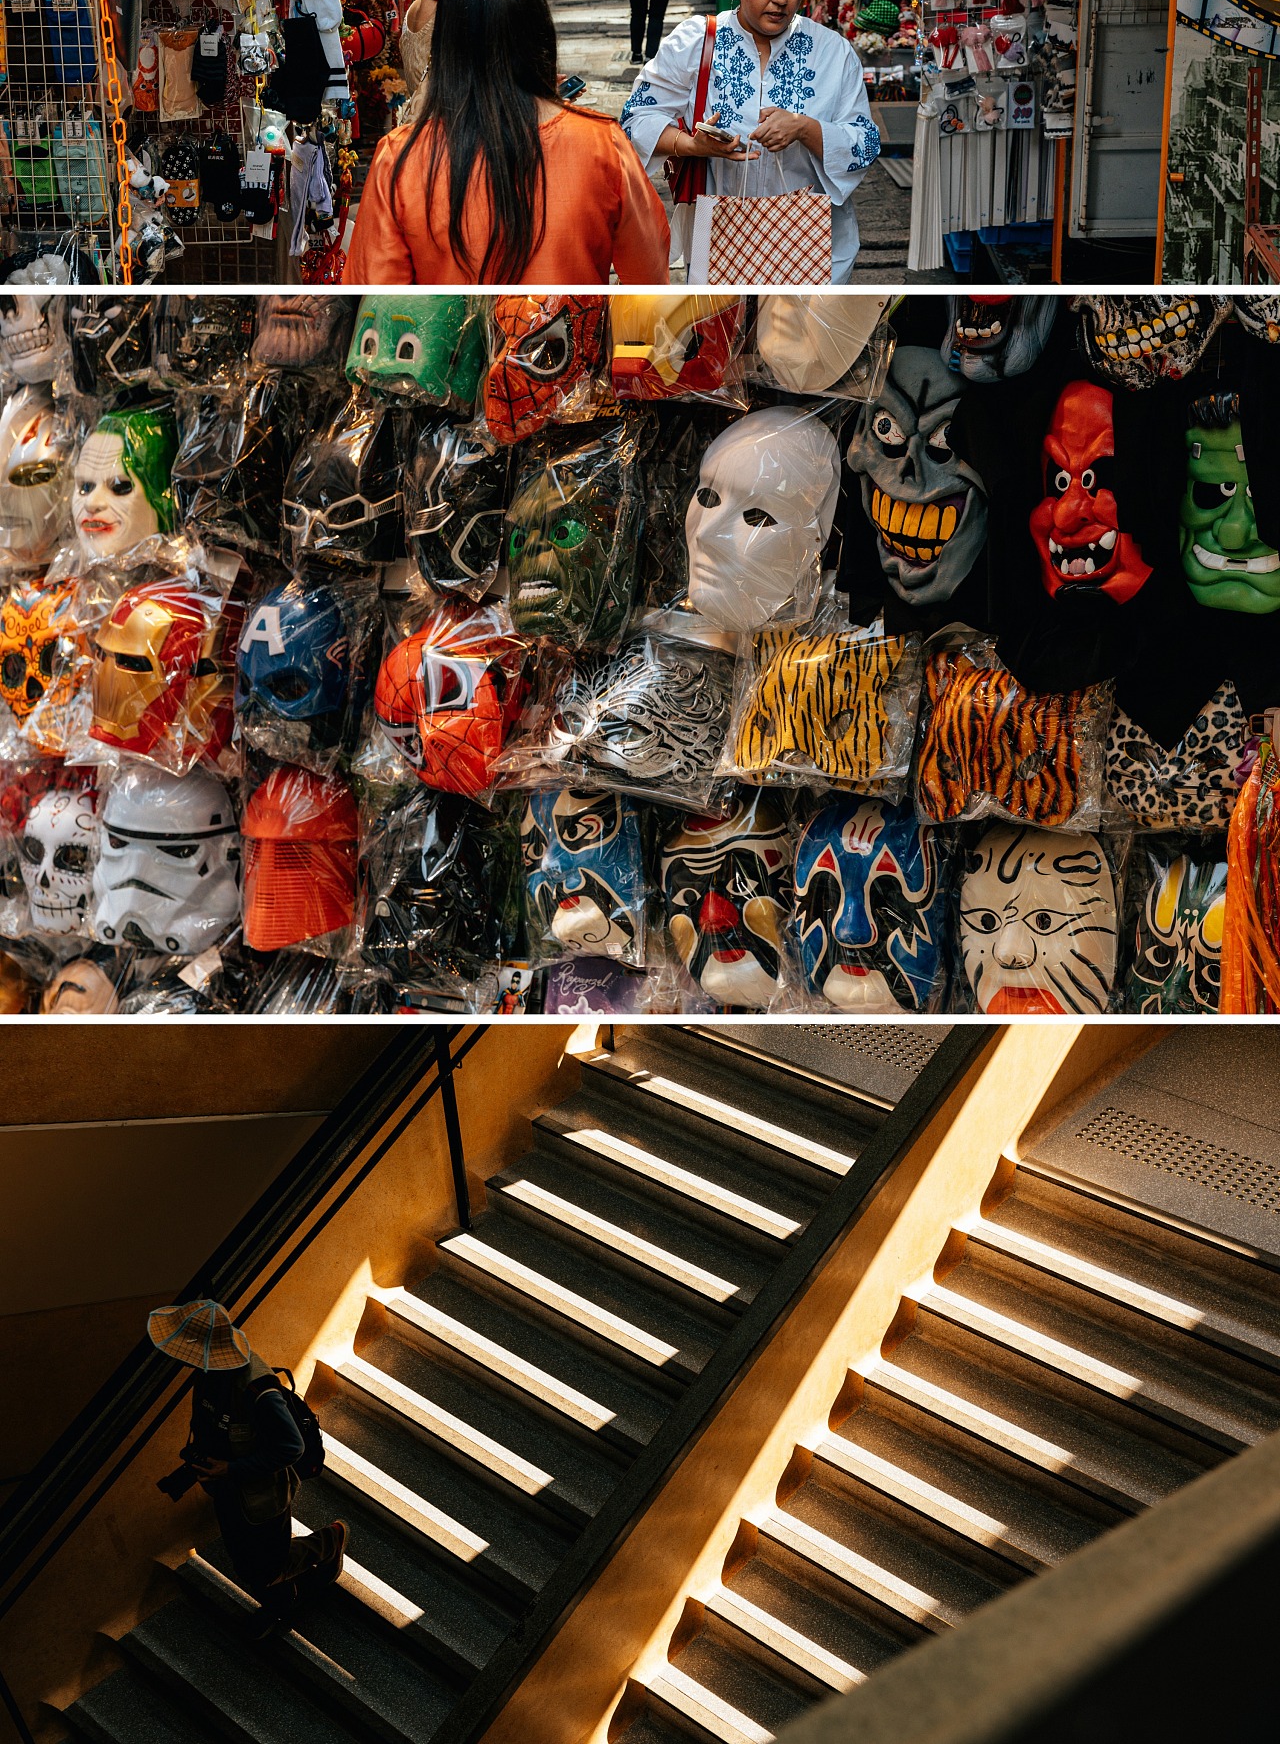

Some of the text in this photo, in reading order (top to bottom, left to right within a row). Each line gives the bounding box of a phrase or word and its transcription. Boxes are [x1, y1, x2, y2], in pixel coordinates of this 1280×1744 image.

[308, 239, 323, 248] $20
[240, 605, 286, 657] A
[552, 962, 613, 996] Rapunzel
